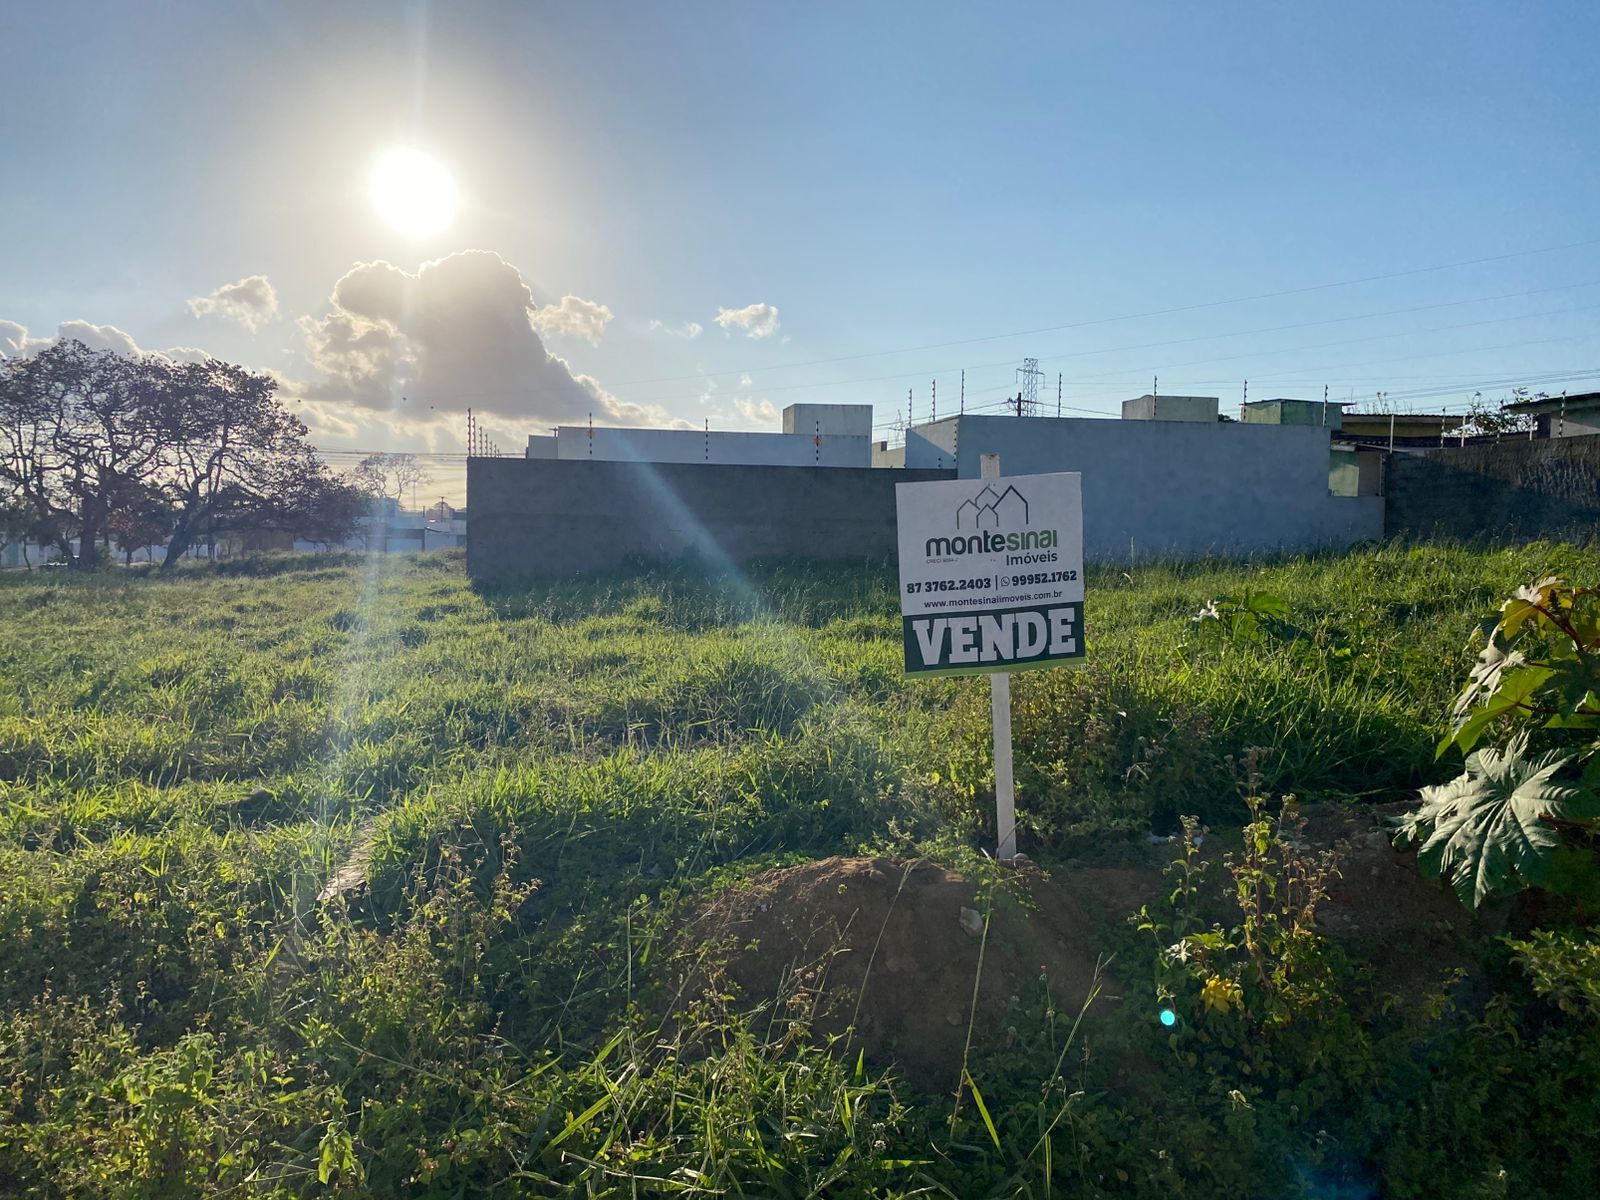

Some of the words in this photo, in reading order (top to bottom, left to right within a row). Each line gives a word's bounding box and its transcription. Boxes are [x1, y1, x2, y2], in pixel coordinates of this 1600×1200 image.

[1006, 551, 1058, 566] Imóveis
[907, 583, 921, 593] 87
[925, 578, 991, 592] 3762.2403
[1012, 570, 1077, 586] 99952.1762
[924, 591, 1063, 608] www.montesinaiimoveis.com.br
[912, 607, 1076, 666] VENDE
